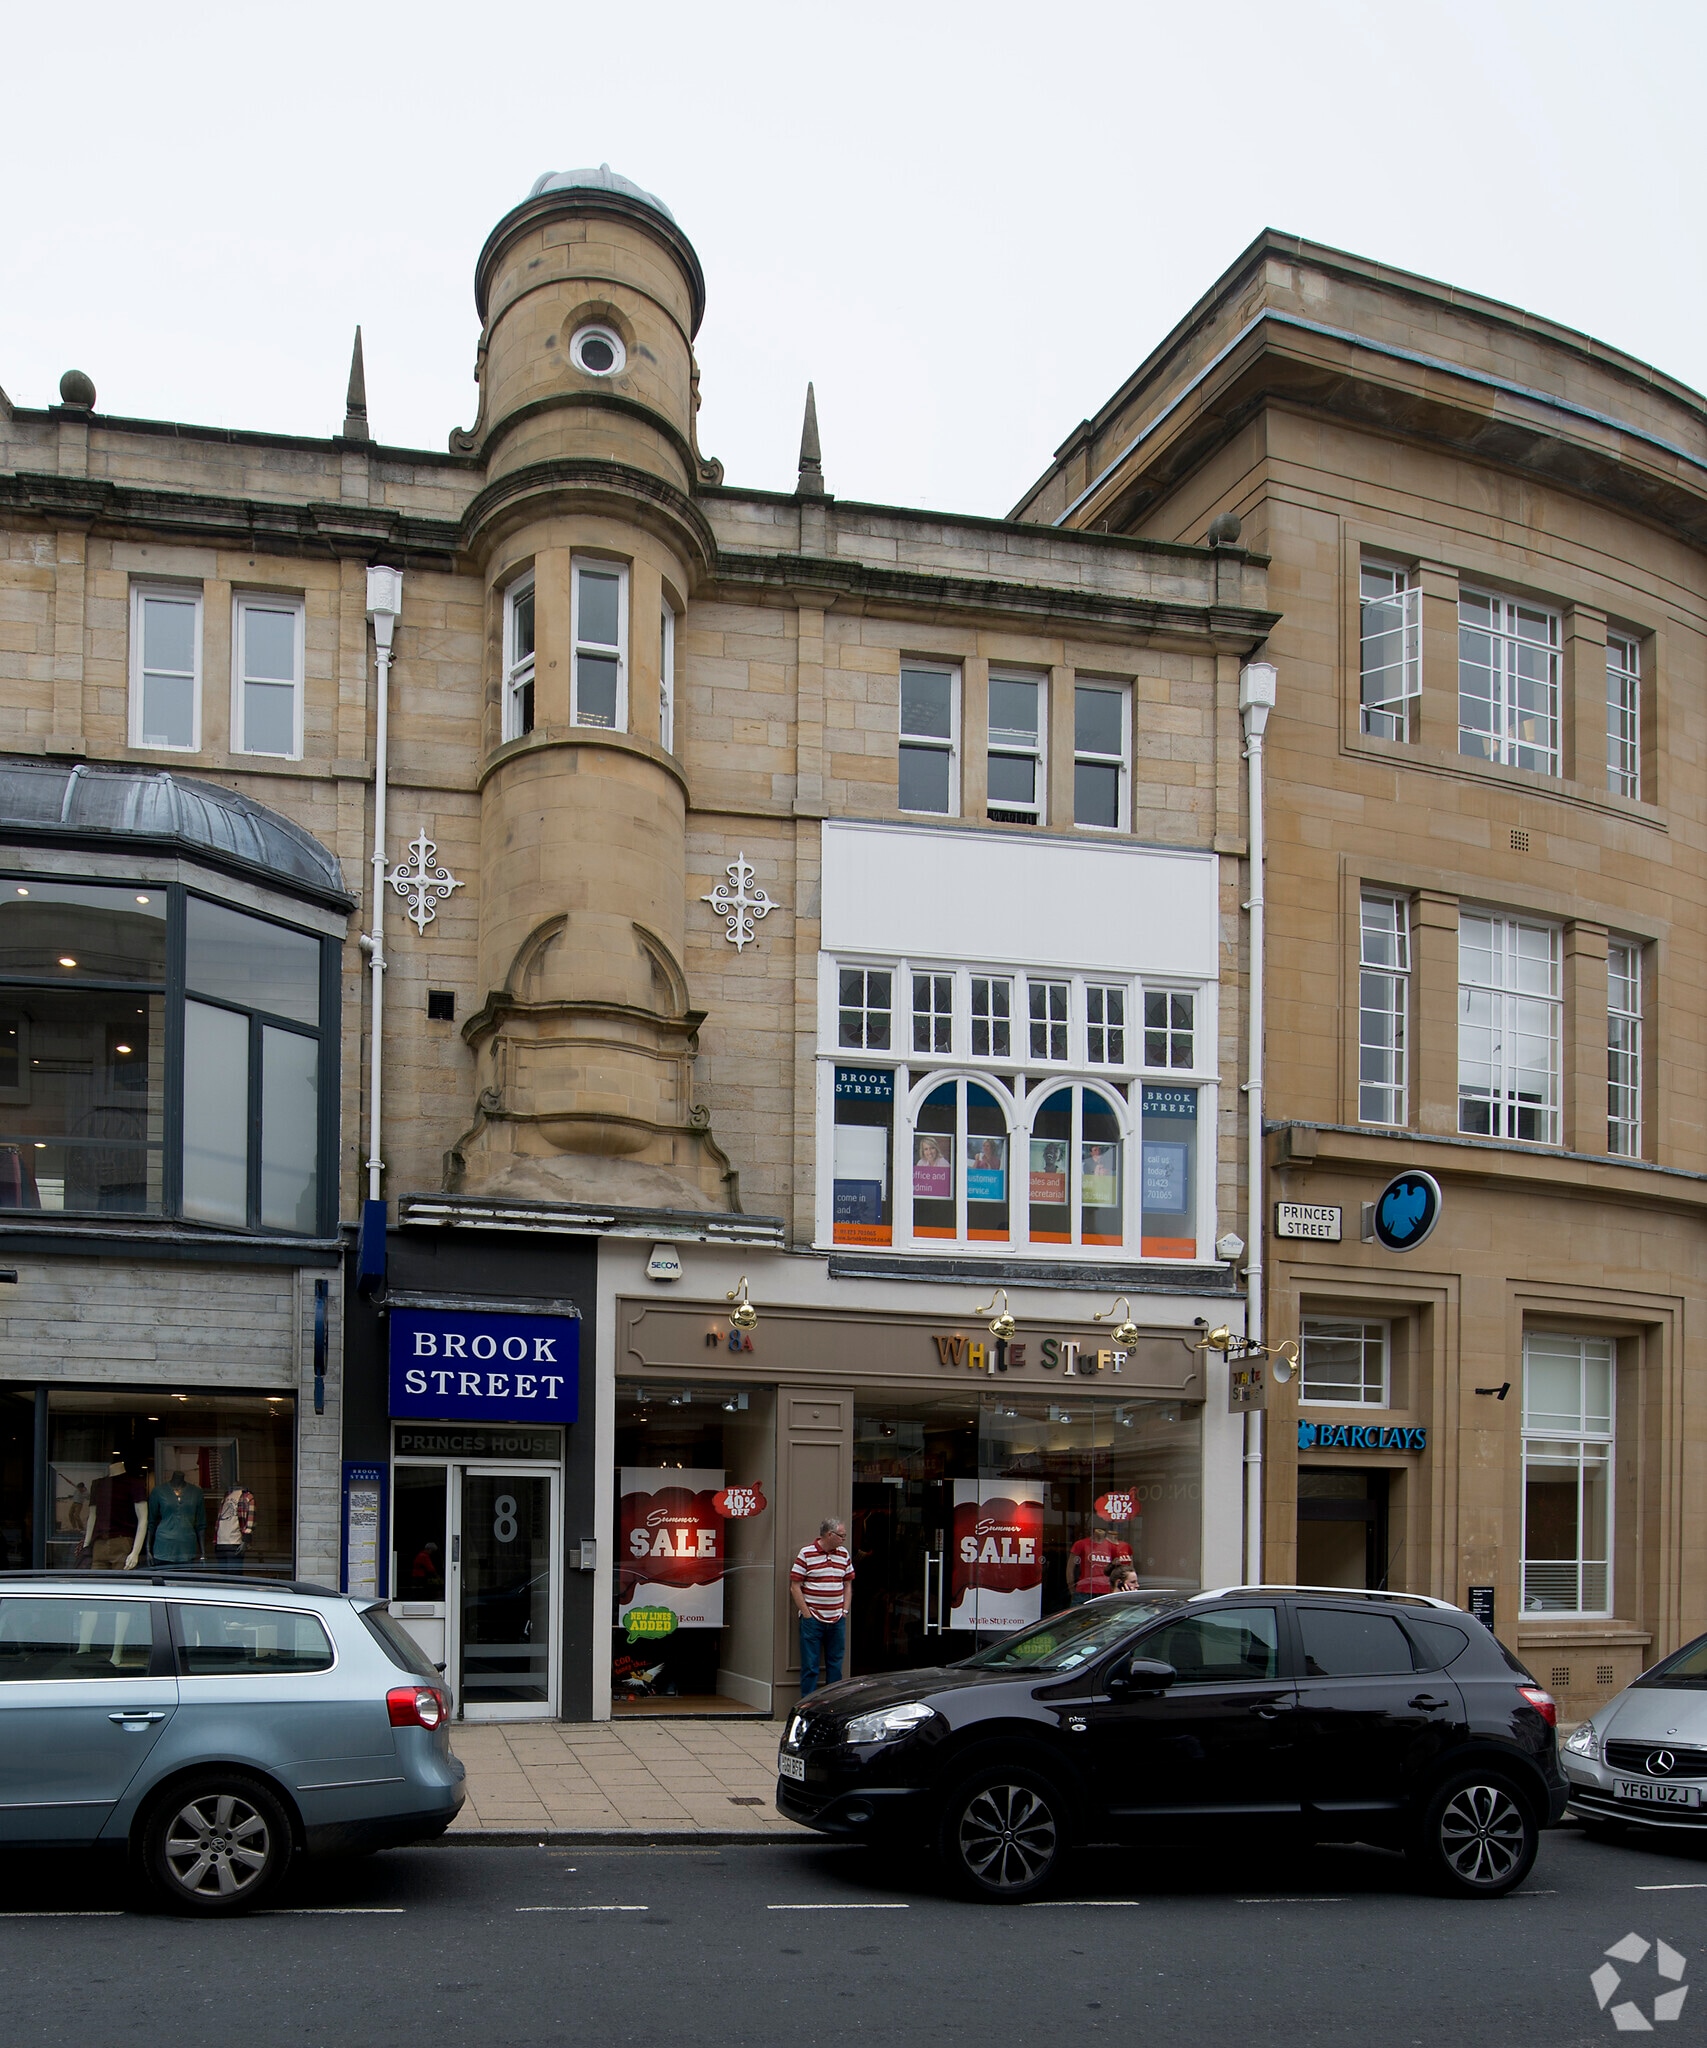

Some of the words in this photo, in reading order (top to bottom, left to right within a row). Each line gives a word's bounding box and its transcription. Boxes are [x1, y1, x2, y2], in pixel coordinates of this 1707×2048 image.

[841, 1073, 887, 1084] BROOK
[836, 1084, 892, 1095] STREET
[1147, 1092, 1190, 1102] BROOK
[1142, 1102, 1195, 1113] STREET
[1147, 1155, 1160, 1163] call
[932, 1172, 945, 1180] and
[1147, 1167, 1167, 1176] today
[967, 1174, 997, 1183] ustomer
[1030, 1178, 1045, 1186] ales
[1047, 1178, 1060, 1186] and
[1147, 1179, 1168, 1187] 01423
[967, 1187, 989, 1195] ervice
[1030, 1190, 1064, 1198] ecretarial
[1147, 1190, 1172, 1199] 701065
[837, 1194, 857, 1202] come
[859, 1194, 866, 1202] in
[837, 1206, 851, 1214] and
[1284, 1206, 1335, 1221] PRINCES
[1288, 1222, 1331, 1236] STREET
[651, 1262, 679, 1270] SECOM
[729, 1329, 754, 1351] 8A
[413, 1332, 557, 1362] BROOK
[405, 1369, 564, 1399] STREET
[1319, 1424, 1427, 1449] BARCLAYS
[401, 1435, 485, 1450] PRINCES
[492, 1438, 554, 1451] HOUSE
[723, 1495, 756, 1509] 40%
[1104, 1500, 1133, 1514] 40%
[646, 1508, 699, 1527] Summer
[731, 1508, 750, 1516] OFF
[494, 1495, 518, 1542] 8
[975, 1518, 1022, 1535] Summer
[630, 1528, 716, 1558] SALE
[960, 1536, 1035, 1564] SALE
[1091, 1554, 1111, 1563] SALE
[630, 1612, 648, 1620] NEW
[649, 1612, 672, 1621] LINES
[630, 1621, 671, 1631] ADDED
[1622, 1782, 1652, 1800] YF61
[1657, 1787, 1689, 1803] UZJ
